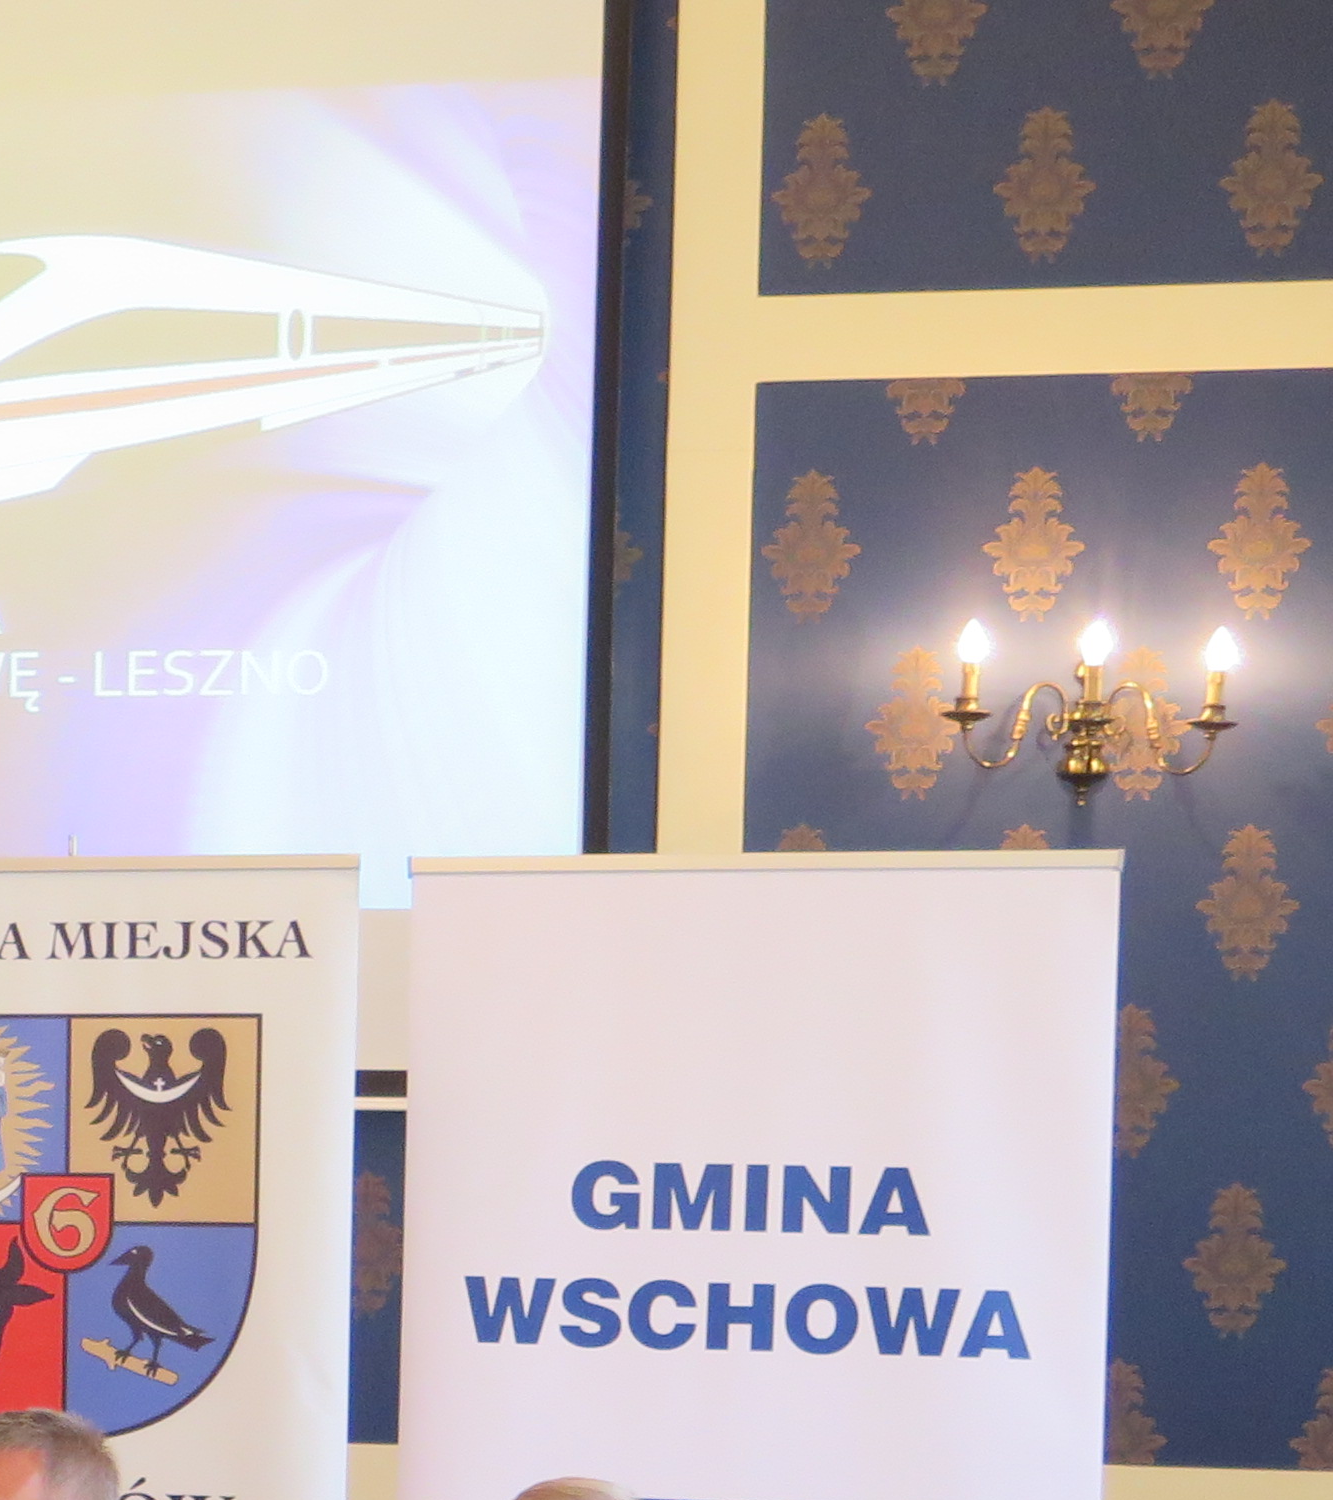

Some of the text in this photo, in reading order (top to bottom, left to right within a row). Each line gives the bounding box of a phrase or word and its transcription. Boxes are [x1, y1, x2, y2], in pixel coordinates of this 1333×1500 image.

[93, 649, 330, 698] LESZNO
[45, 918, 315, 961] MIEJSKA
[569, 1158, 932, 1237] GMINA
[463, 1274, 1033, 1361] WSCHOWA
